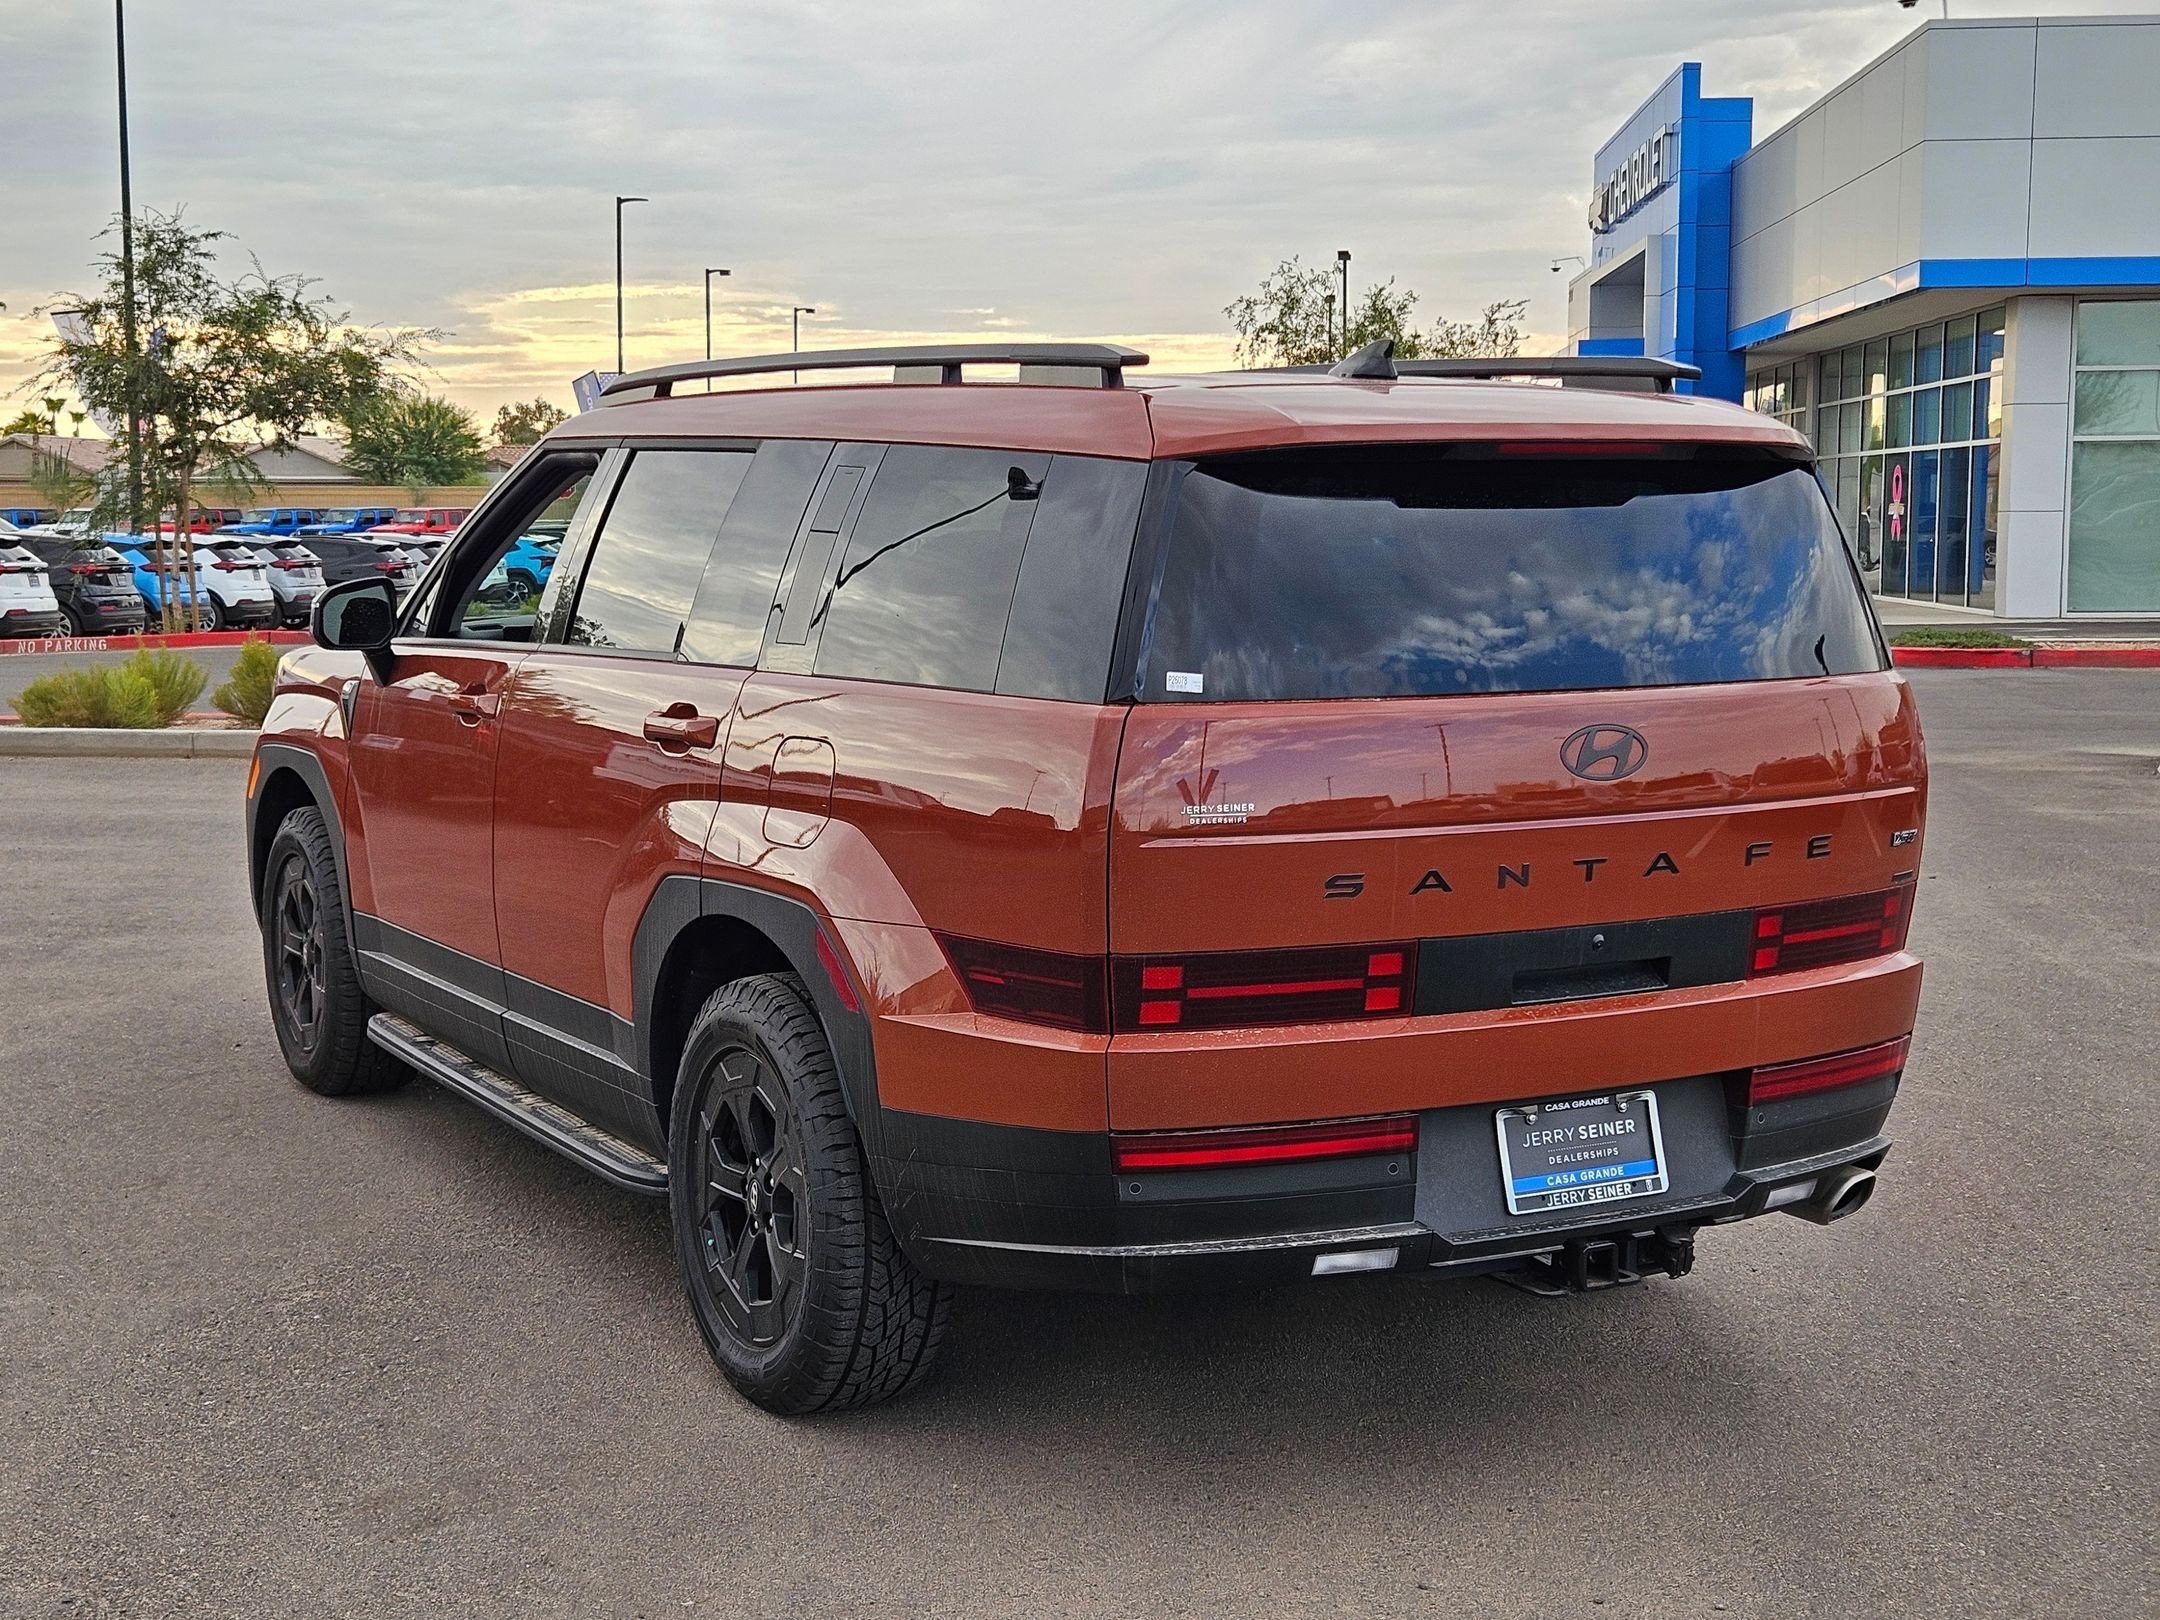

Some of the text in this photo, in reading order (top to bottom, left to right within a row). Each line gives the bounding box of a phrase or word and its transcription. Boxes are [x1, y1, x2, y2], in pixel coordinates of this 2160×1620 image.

[1608, 123, 1673, 225] CHEVROLET
[18, 639, 107, 653] NO PARKING
[1180, 803, 1255, 815] JERRY SEINER
[1189, 816, 1248, 825] DEALERSHIPS
[1323, 833, 1833, 899] SANTA FE
[1545, 1097, 1609, 1112] CASA GRANDE
[1523, 1119, 1635, 1148] JERRY SEINER
[1548, 1147, 1619, 1165] DEALERSHIPS
[1546, 1166, 1624, 1186] CASA GRANDE
[1546, 1182, 1632, 1207] JERRY SEINER
